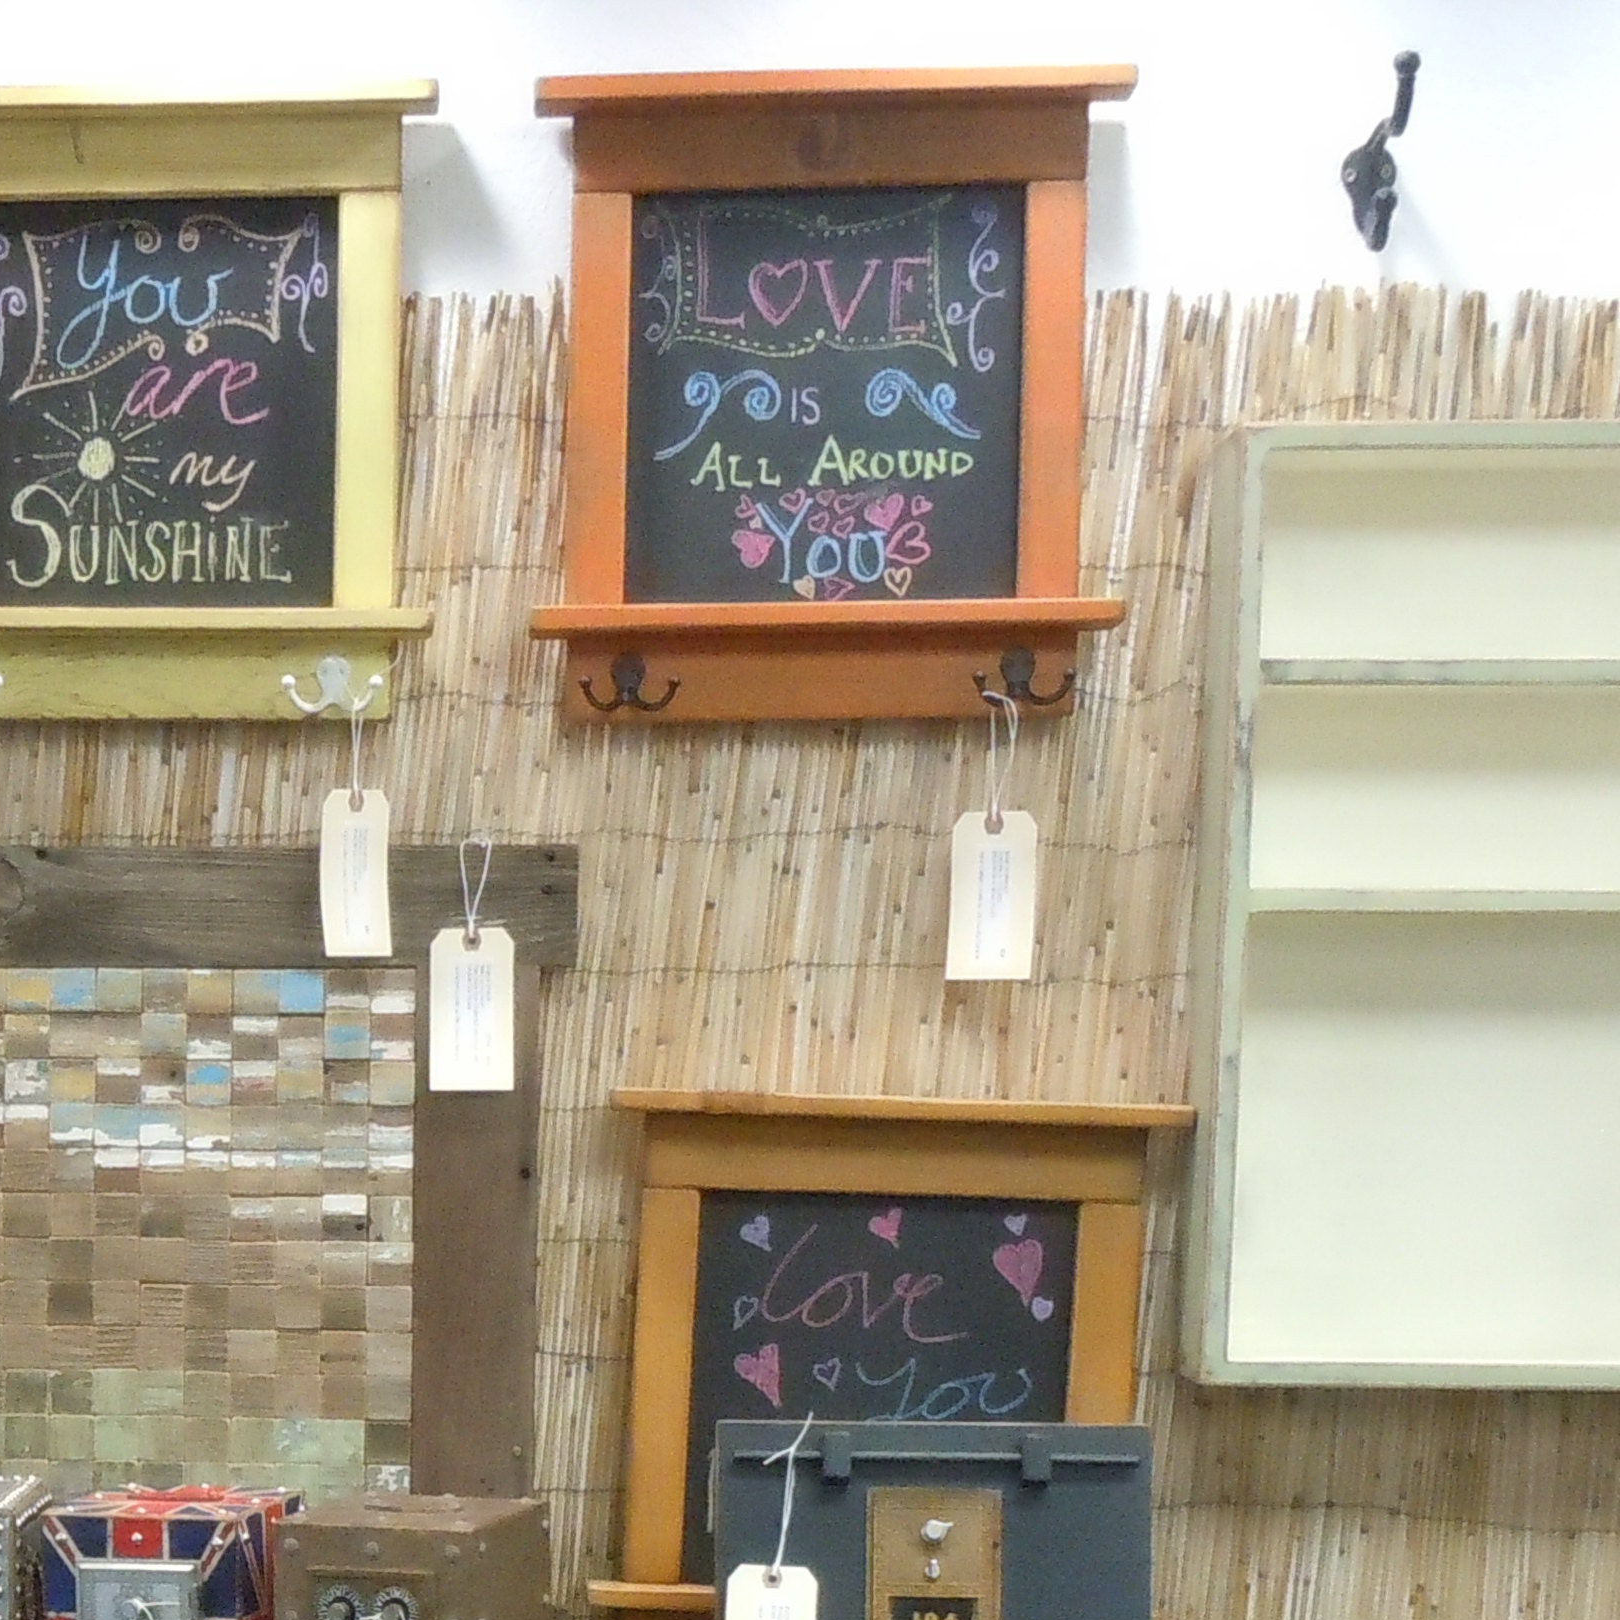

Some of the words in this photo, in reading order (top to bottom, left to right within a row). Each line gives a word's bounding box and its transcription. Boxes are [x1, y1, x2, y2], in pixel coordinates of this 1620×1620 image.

[56, 234, 235, 369] You
[125, 358, 270, 426] are
[168, 450, 256, 513] my
[689, 441, 781, 492] ALL
[807, 434, 975, 486] AROUND
